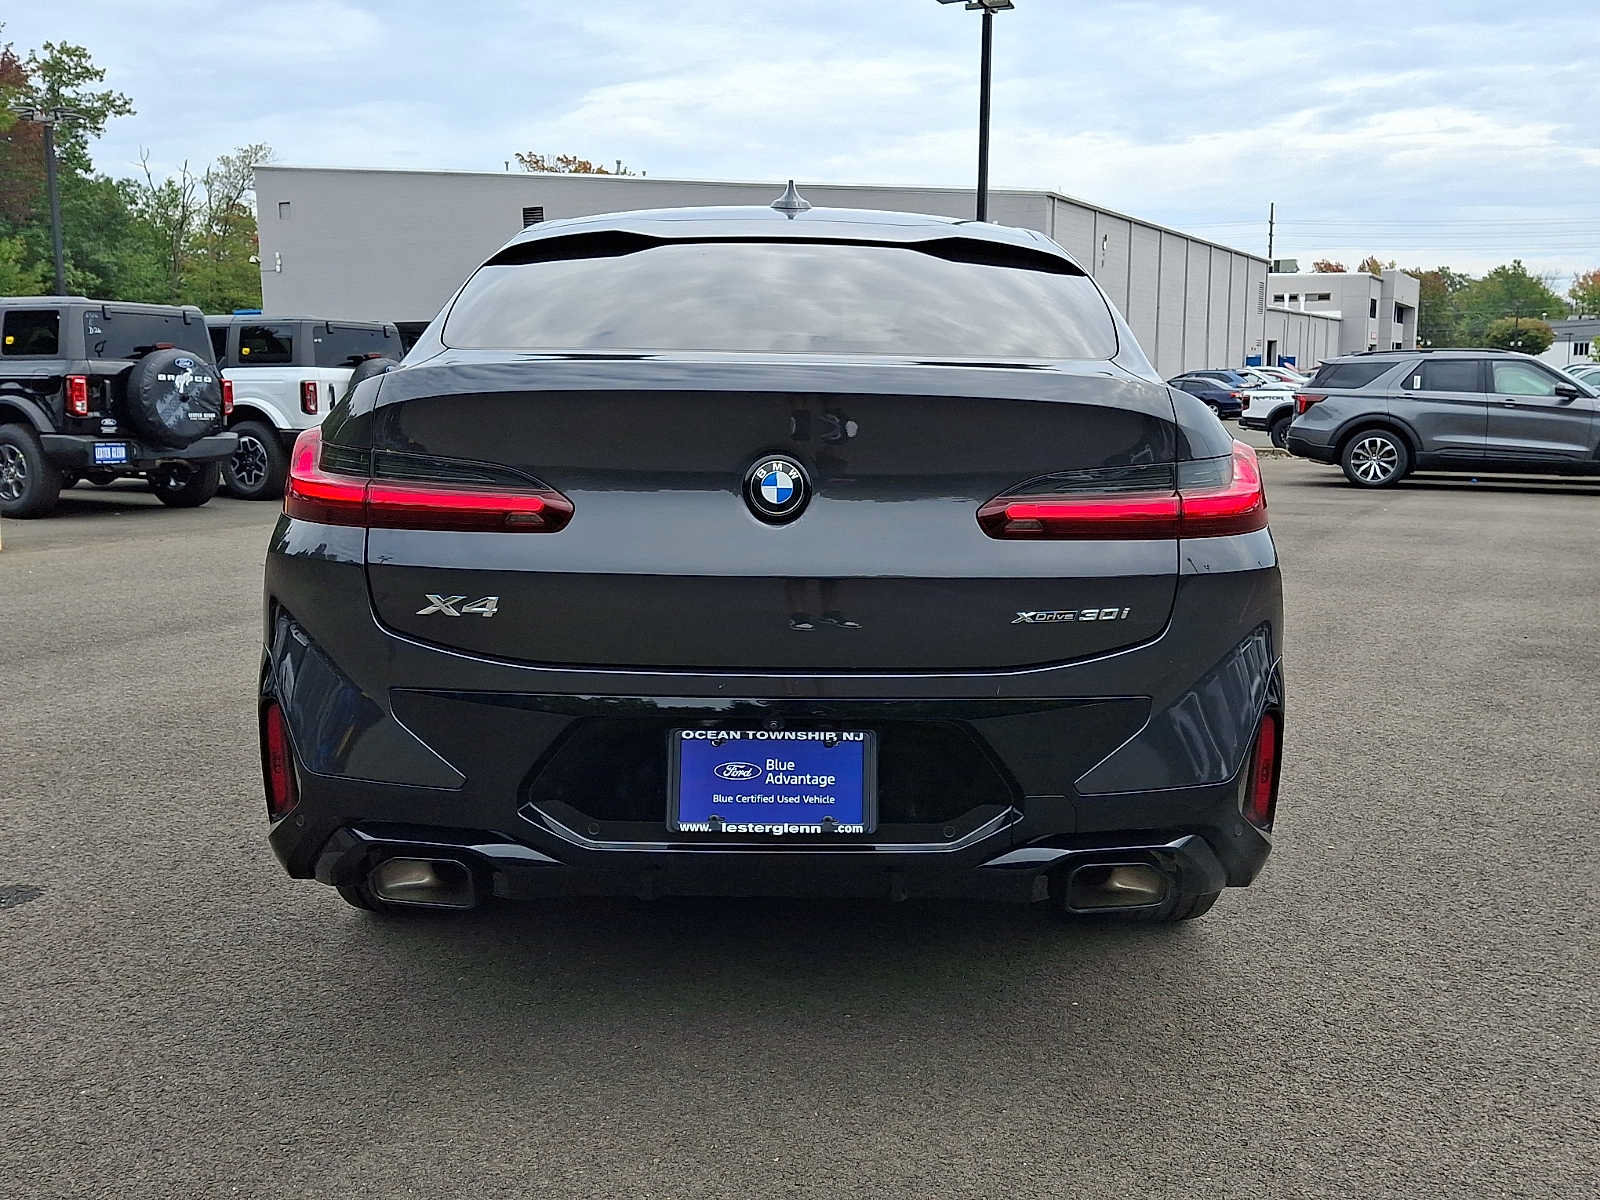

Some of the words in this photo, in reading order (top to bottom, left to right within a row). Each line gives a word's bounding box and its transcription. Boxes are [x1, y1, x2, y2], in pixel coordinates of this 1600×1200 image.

[157, 373, 212, 383] BRCO
[756, 463, 799, 480] BMW
[415, 594, 499, 617] X4
[1079, 607, 1131, 621] 30i
[681, 730, 741, 740] OCEAN
[842, 732, 864, 741] NJ
[765, 759, 796, 771] Blue
[765, 773, 836, 787] Advantage
[712, 794, 734, 803] Blue
[736, 794, 775, 803] Certified
[777, 794, 800, 804] Used
[802, 795, 835, 804] Vehicle
[679, 823, 712, 832] www.
[721, 823, 821, 835] lesterglenn
